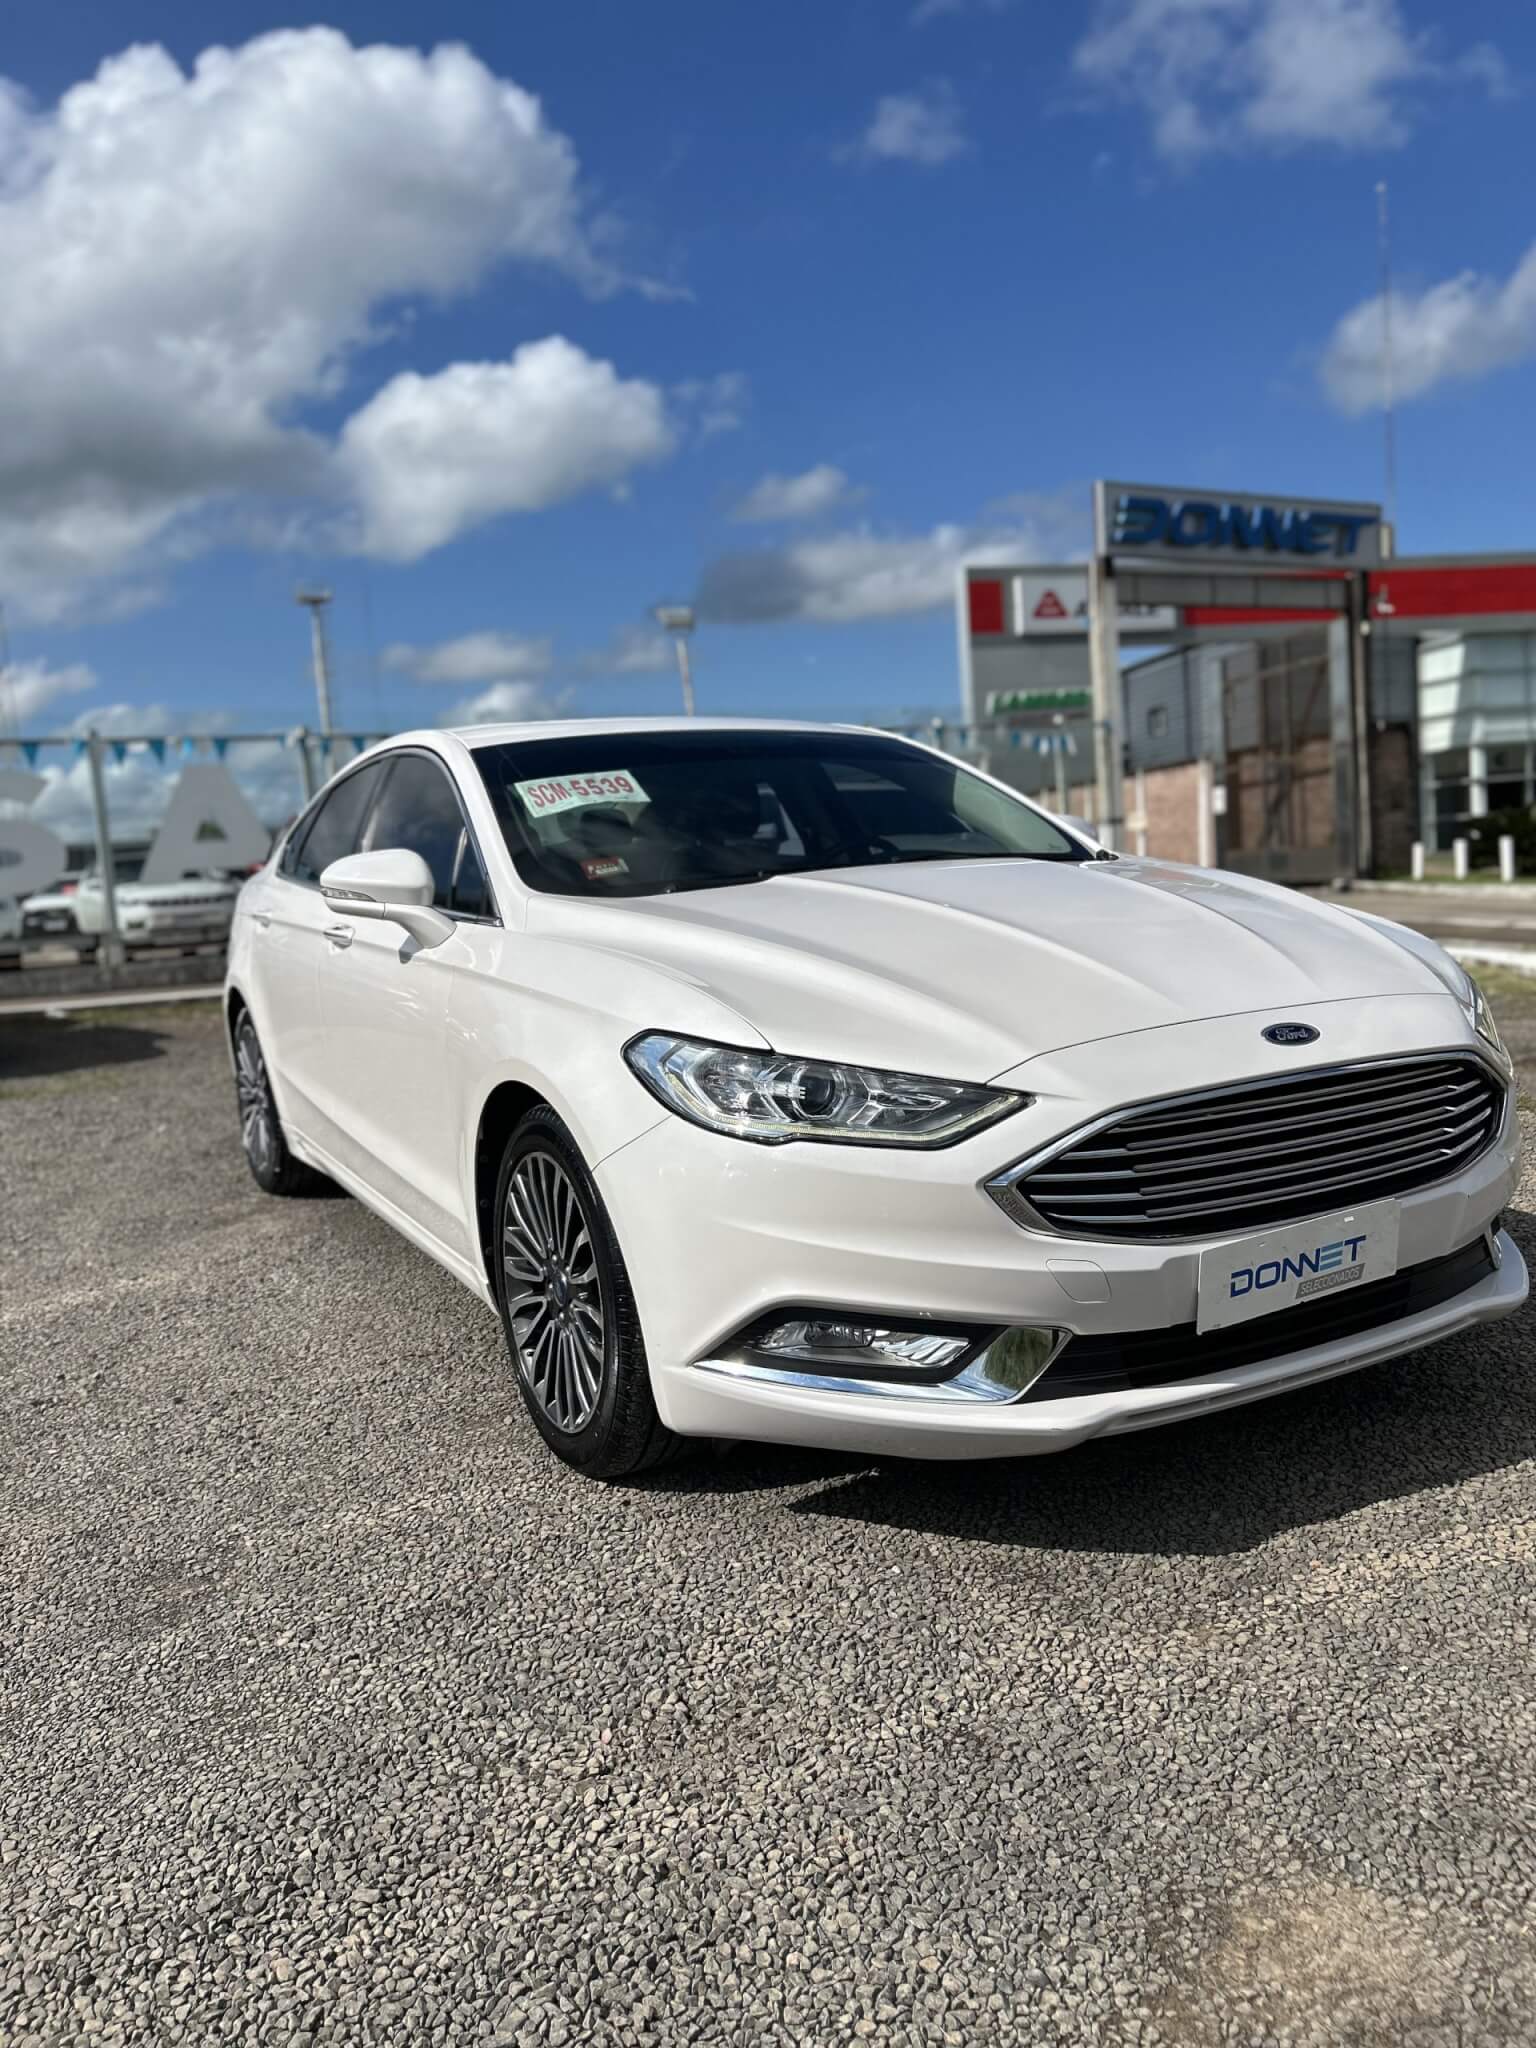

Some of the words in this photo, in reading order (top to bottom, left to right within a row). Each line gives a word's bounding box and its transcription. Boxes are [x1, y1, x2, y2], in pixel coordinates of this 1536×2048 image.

[1111, 494, 1380, 556] DONNET
[1275, 1027, 1308, 1041] Ford
[1230, 1235, 1367, 1298] DONNET
[1301, 1266, 1361, 1295] SELECCIONADOS
